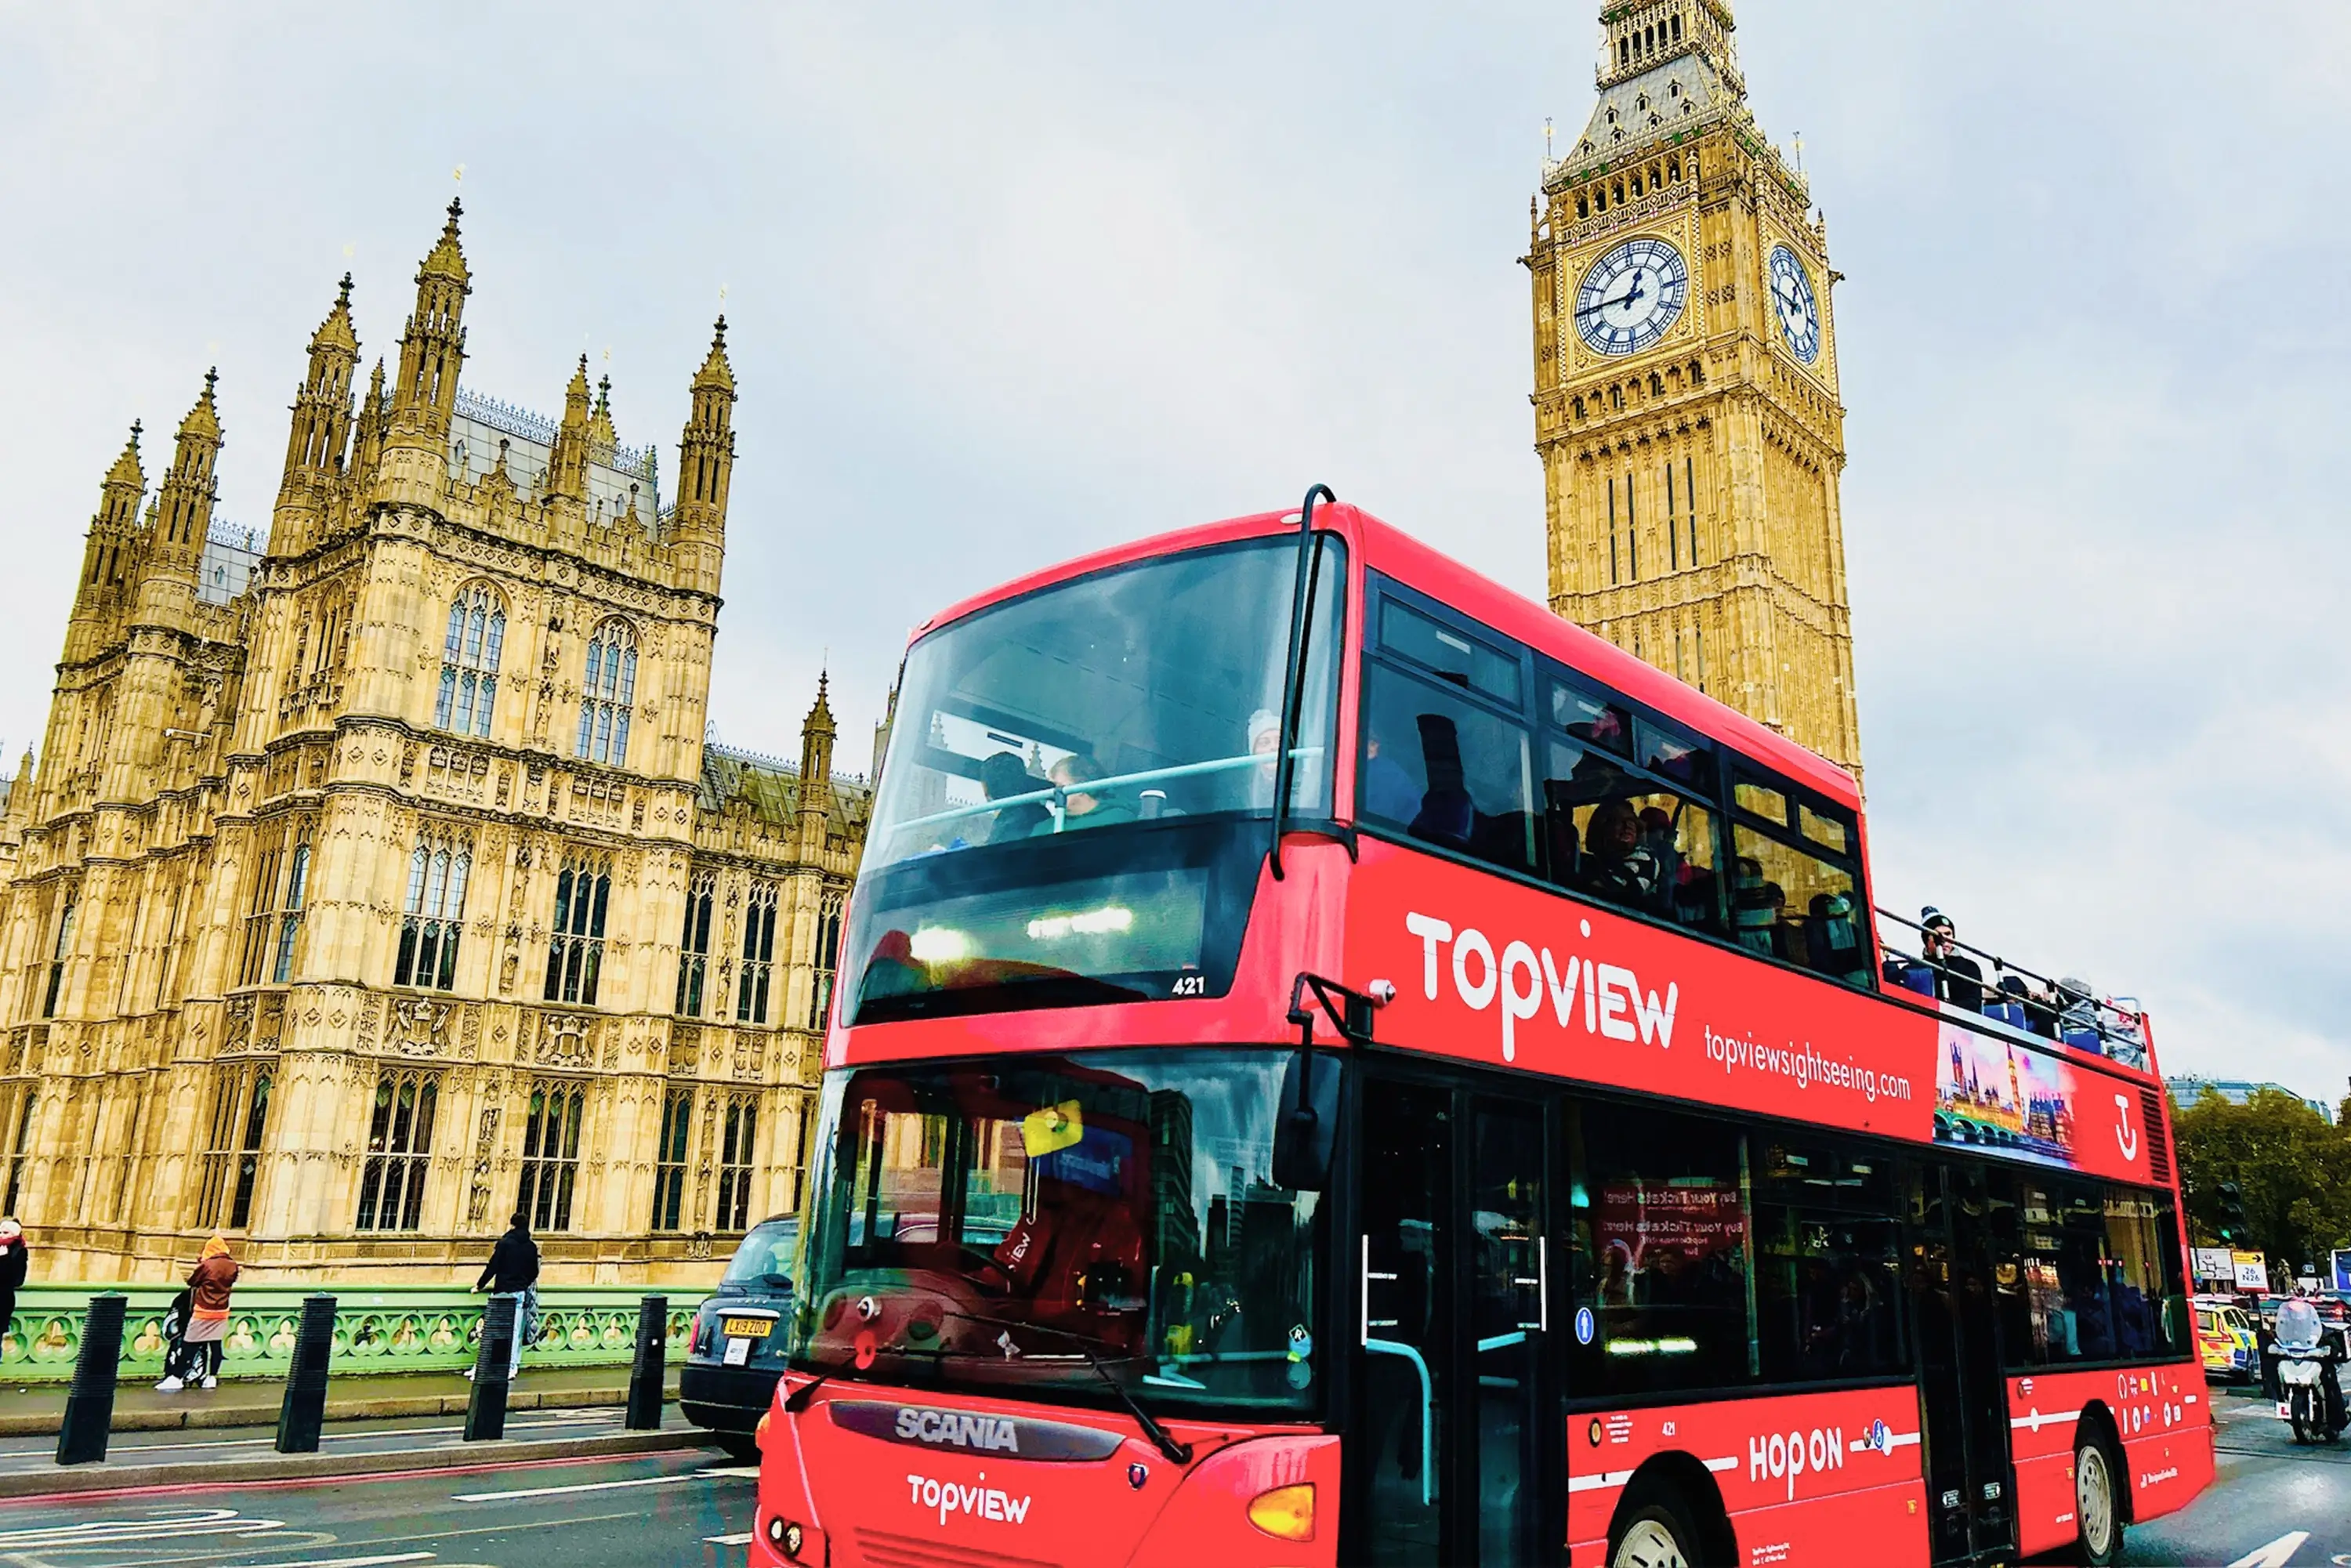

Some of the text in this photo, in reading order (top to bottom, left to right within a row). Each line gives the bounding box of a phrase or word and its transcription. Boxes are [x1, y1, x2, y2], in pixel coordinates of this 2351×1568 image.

[1172, 976, 1204, 995] 421
[1704, 1024, 1911, 1103] topviewsightseeing.com
[895, 1408, 1019, 1453] SCANIA
[2281, 1407, 2290, 1416] L
[1809, 1427, 1843, 1472] ON
